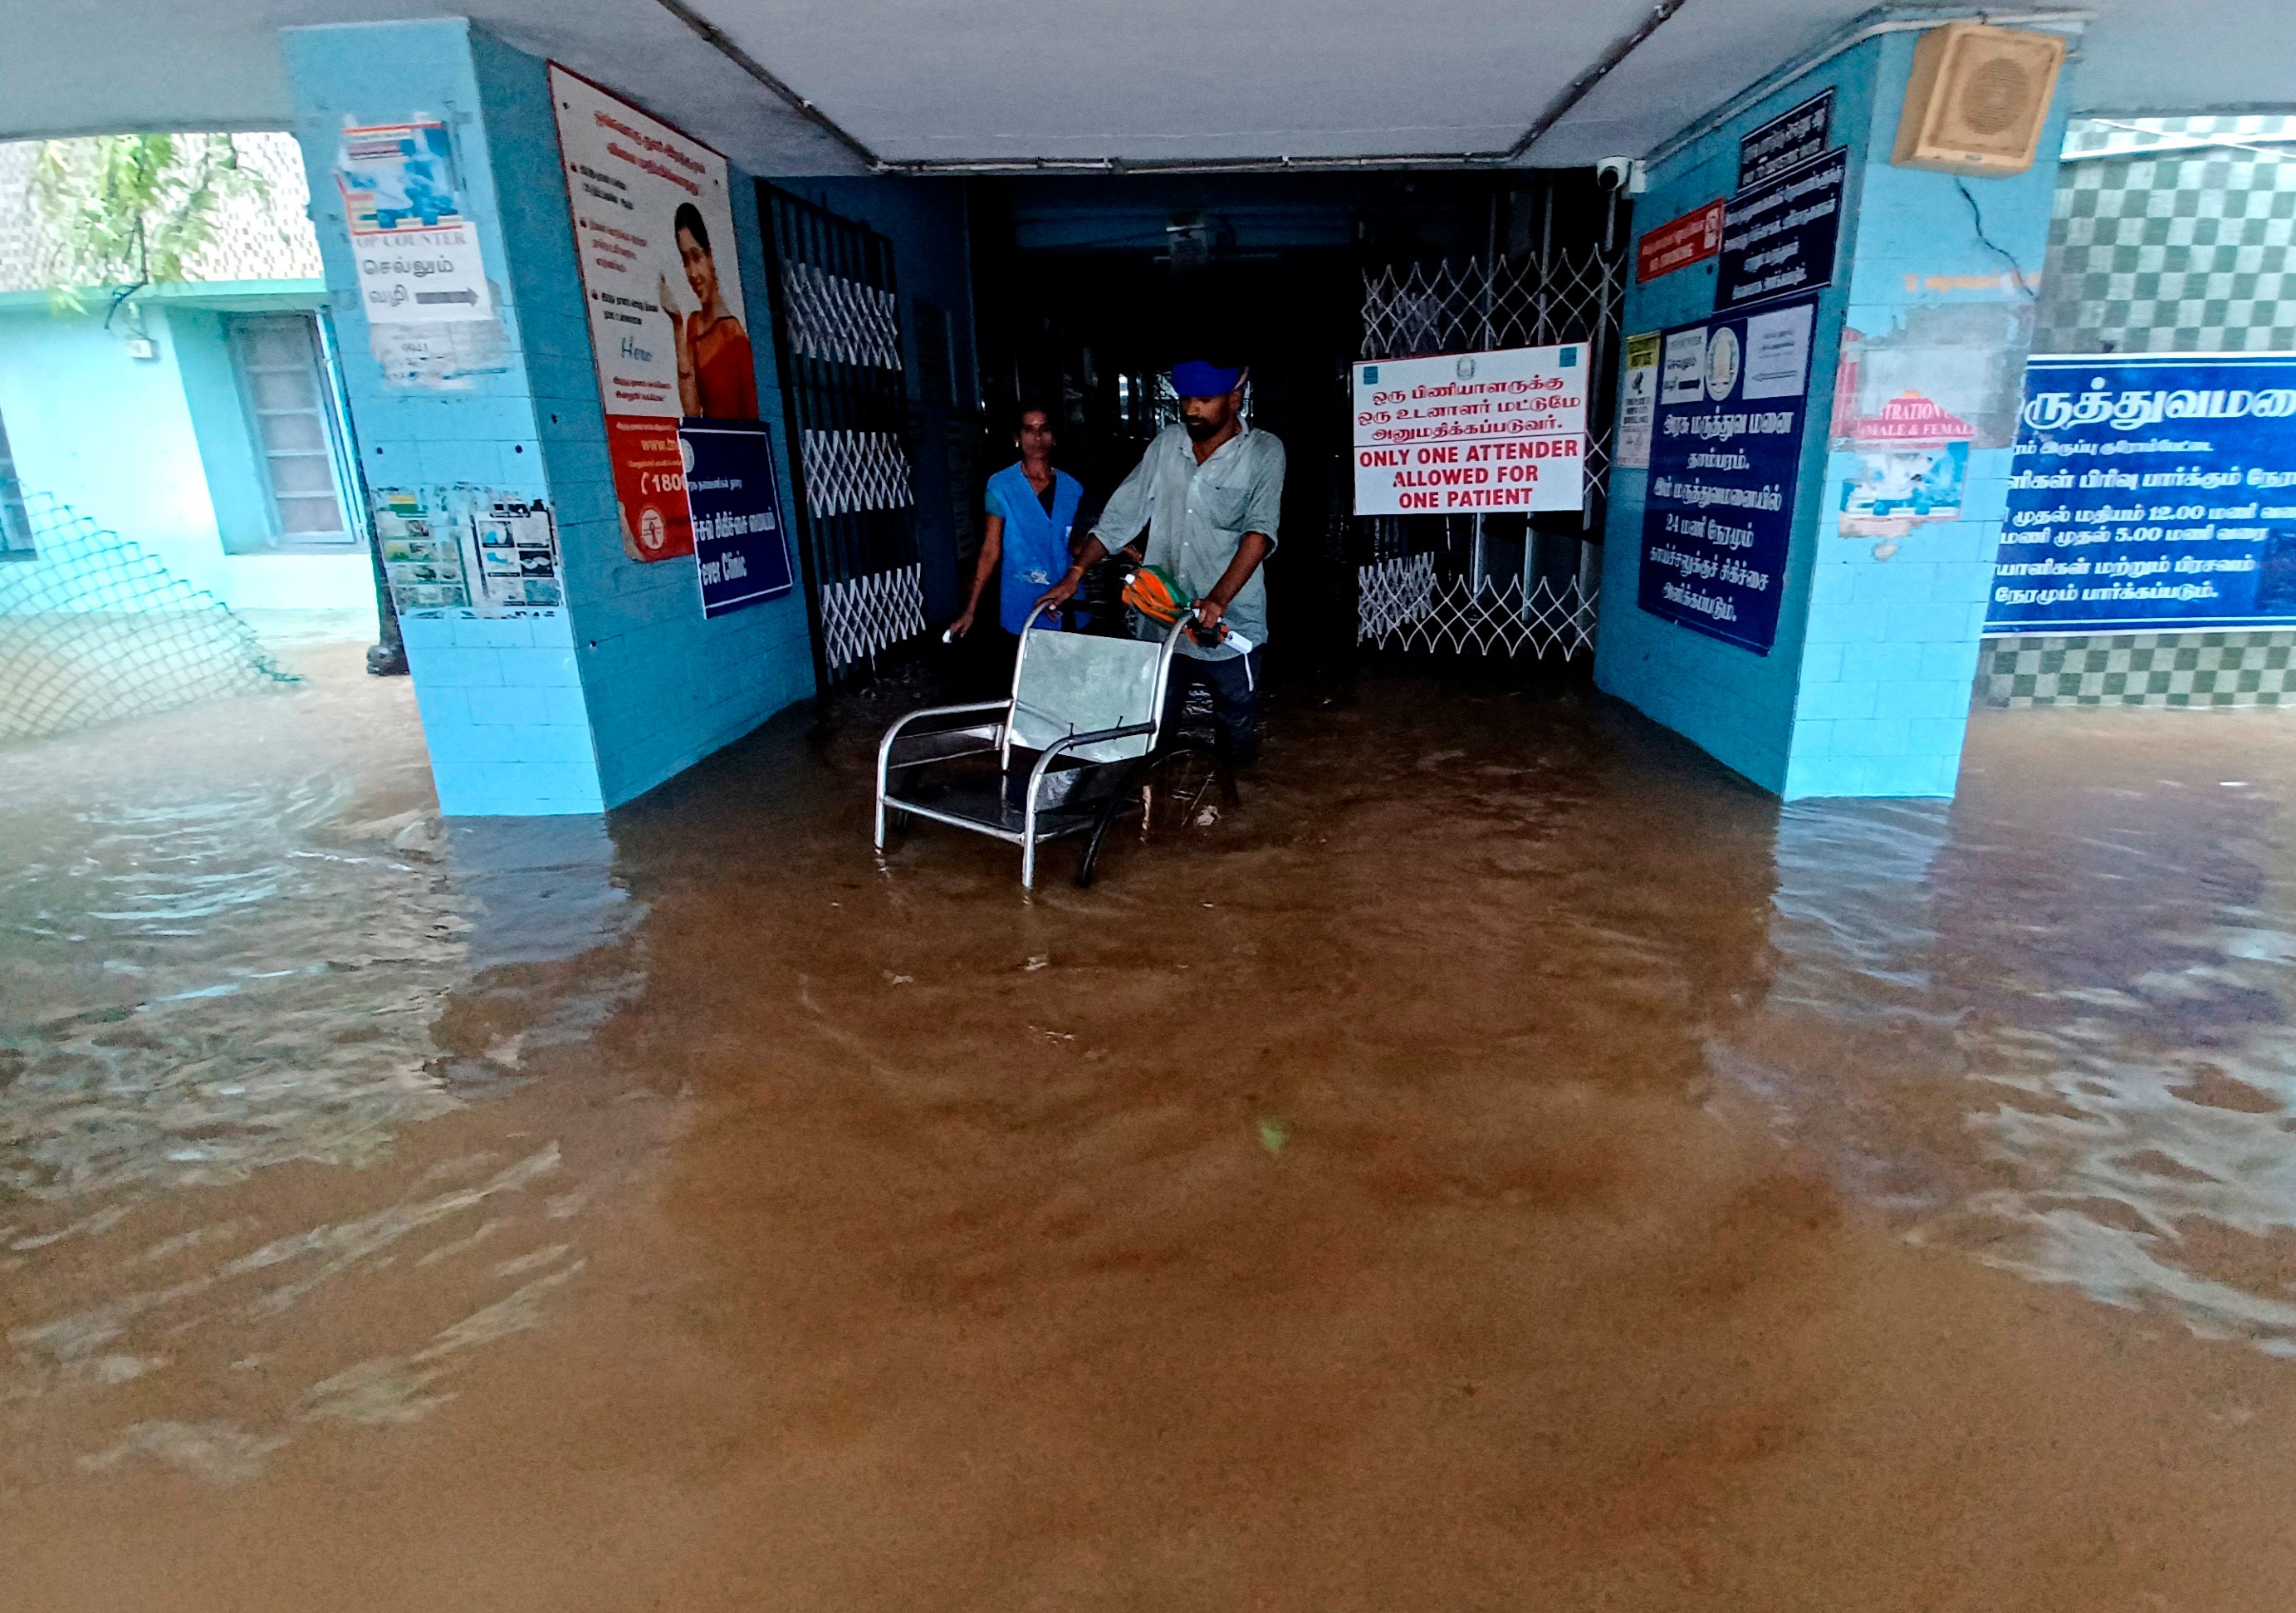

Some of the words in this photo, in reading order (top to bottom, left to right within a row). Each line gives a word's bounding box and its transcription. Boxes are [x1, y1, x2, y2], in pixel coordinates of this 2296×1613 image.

[363, 254, 454, 277] செல்லும்
[369, 284, 409, 307] வழி
[1373, 390, 1407, 405] ஒரு
[1412, 374, 1564, 400] பிணியாளருக்கு
[1358, 409, 1391, 426] ஒரு
[1396, 399, 1491, 419] உடனாளர்
[1497, 395, 1581, 413] மட்டுமே
[1881, 403, 1942, 420] TRATION
[1372, 414, 1563, 443] அனுமதிக்கப்படுவர்.
[1663, 414, 1690, 439] அரசு
[1691, 405, 1747, 442] மருத்துவ
[1748, 412, 1794, 434] மனை
[1908, 424, 1919, 435] &
[1923, 423, 1975, 435] FEMAL
[1359, 449, 1410, 468] ONLY
[1417, 446, 1458, 465] ONE
[1466, 439, 1578, 462] ATTENDER
[1687, 446, 1750, 471] தாம்பரம்.
[1393, 468, 1489, 488] ALLOWED
[1497, 465, 1538, 483] FOR
[2079, 468, 2139, 490] பிரிவு
[2142, 466, 2242, 489] பார்க்கும்
[2247, 468, 2296, 489] நேர
[1398, 492, 1439, 508] ONE
[1447, 488, 1533, 507] PATIENT
[1673, 477, 1782, 512] மருத்துவமனையில்
[2012, 504, 2072, 527] முதல்
[2075, 503, 2146, 525] மதியம்
[2148, 505, 2205, 521] 12.00
[2208, 503, 2259, 520] மணி
[1665, 513, 1679, 532] 24
[1681, 516, 1707, 538] மணி
[1707, 518, 1754, 551] நேரமும்
[2000, 527, 2052, 545] மணி
[2054, 525, 2112, 547] முதல்
[2114, 527, 2163, 542] 5.00
[2164, 524, 2215, 542] மணி
[2216, 527, 2270, 542] வரை
[701, 560, 721, 586] ever
[722, 550, 747, 581] Clinic
[1720, 557, 1770, 591] சிகிச்சை
[1995, 557, 2092, 576] யாளிகள்
[2094, 555, 2171, 578] மற்றும்
[2174, 553, 2257, 574] பிரசவம்
[1662, 581, 1737, 622] அளிக்கப்படும்.
[1995, 583, 2079, 605] நேரமும்
[2081, 580, 2219, 601] பார்க்கப்படும்.
